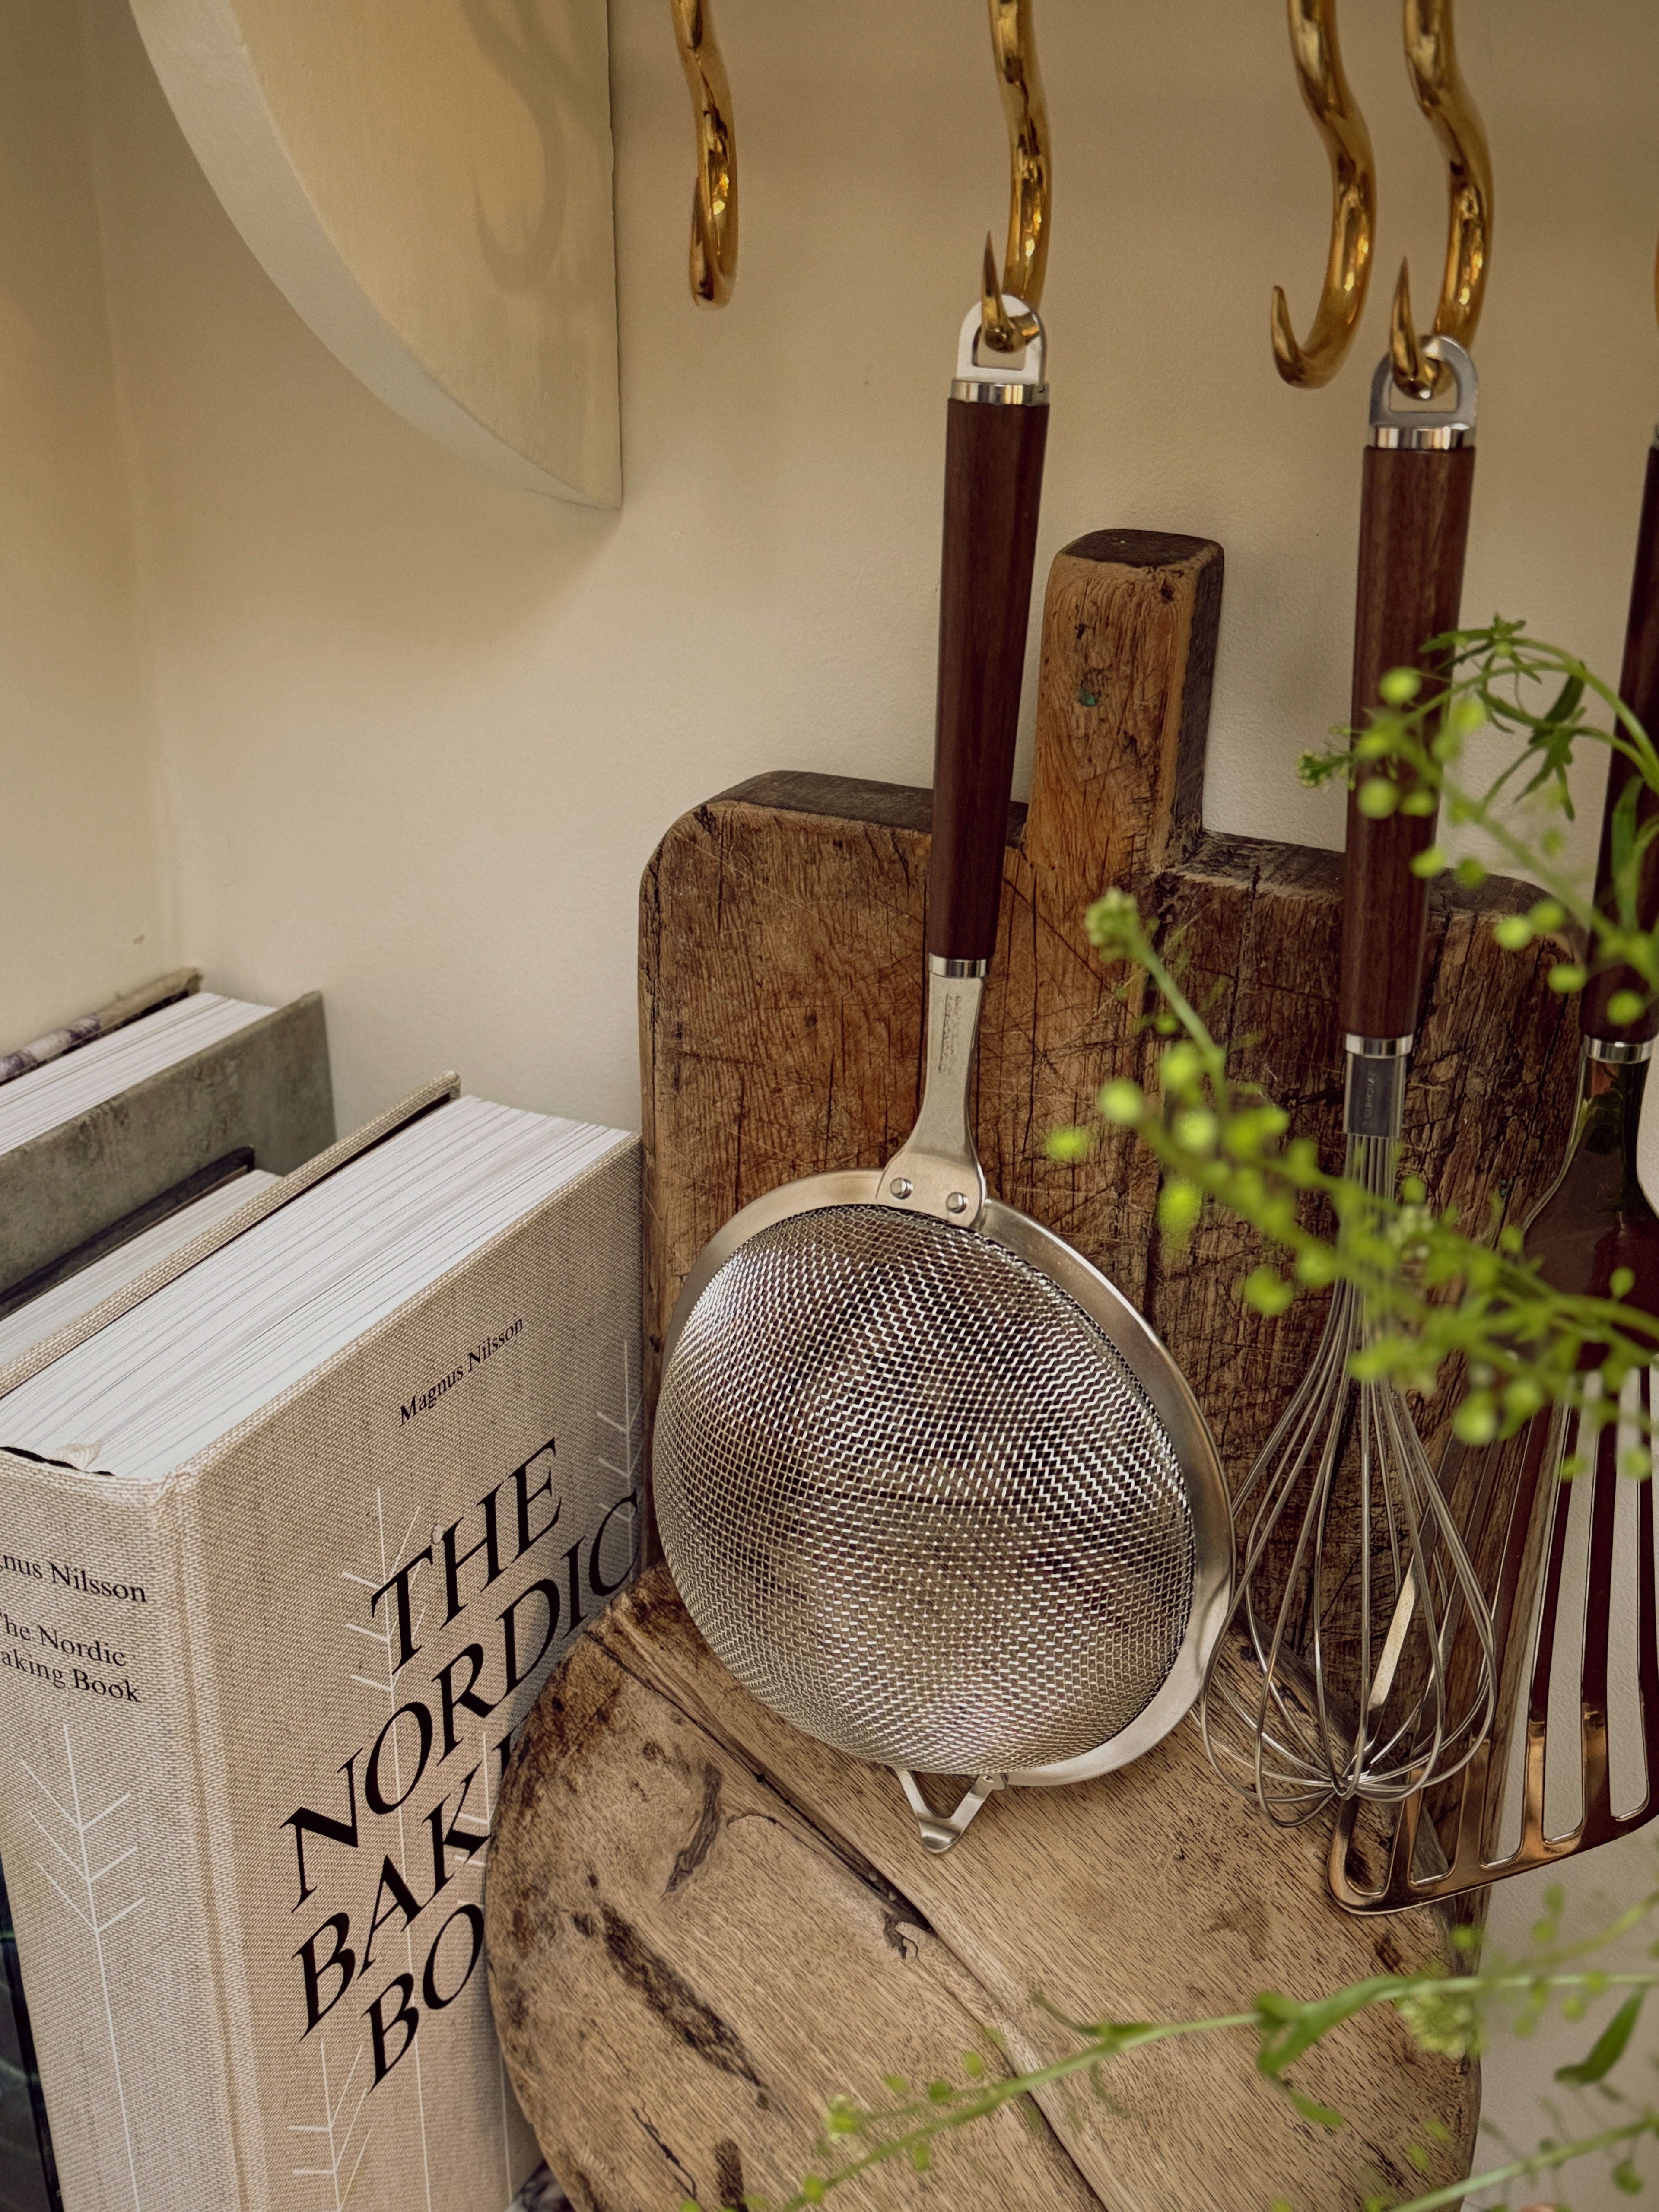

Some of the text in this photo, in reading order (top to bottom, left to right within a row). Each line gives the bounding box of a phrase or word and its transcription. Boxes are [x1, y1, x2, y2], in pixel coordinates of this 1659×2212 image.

[399, 1318, 524, 1426] Magnus Nilsson
[0, 1555, 146, 1602] nus Nilsson
[370, 1437, 562, 1675] THE
[0, 1612, 126, 1666] he Nordic
[1, 1649, 141, 1703] aking Book
[279, 1485, 640, 1913] NORDIC
[292, 1728, 513, 2041] BAK
[362, 1904, 485, 2090] BO
